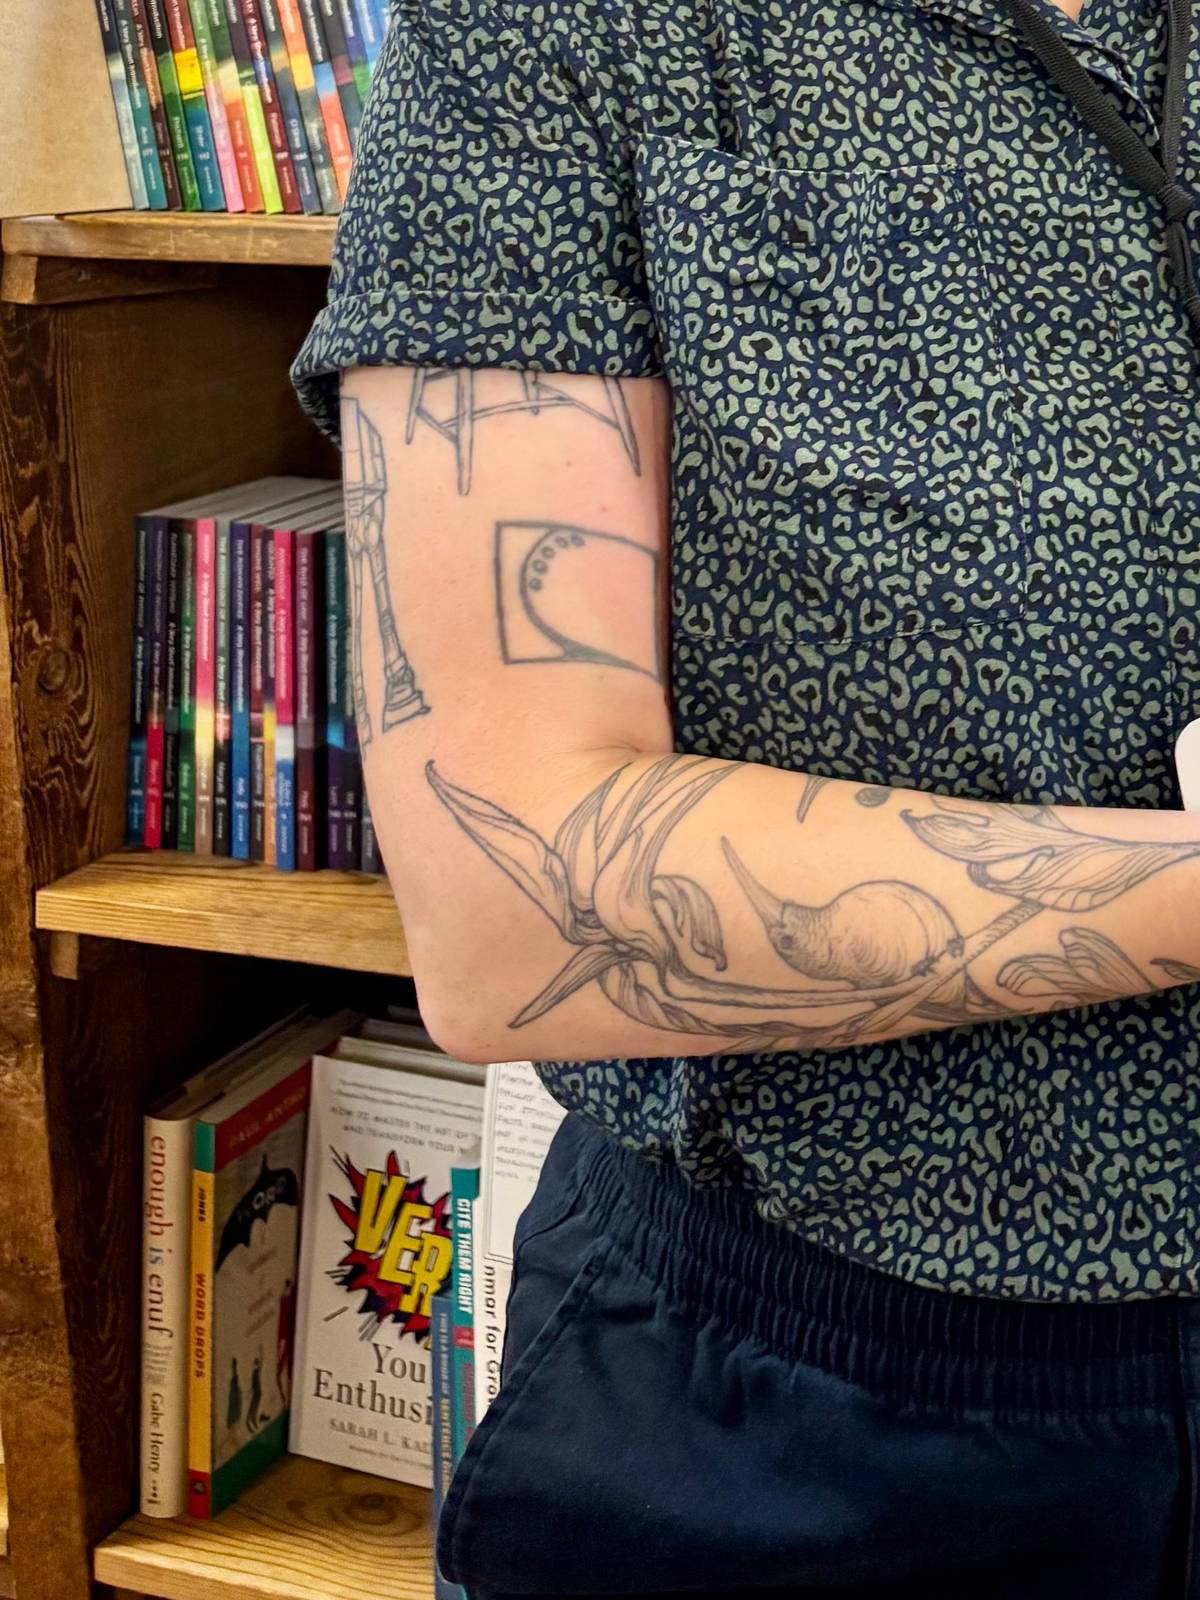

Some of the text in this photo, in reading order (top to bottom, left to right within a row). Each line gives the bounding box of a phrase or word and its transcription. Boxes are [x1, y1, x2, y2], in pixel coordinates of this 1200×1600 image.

[148, 1135, 174, 1238] enough
[148, 1246, 173, 1266] is
[456, 1197, 473, 1315] CITE THEM RIGHT
[146, 1272, 174, 1339] enuf
[194, 1273, 207, 1379] WORD DROPS
[485, 1323, 500, 1353] for
[372, 1343, 426, 1384] You
[151, 1391, 164, 1429] Gabe
[147, 1432, 165, 1476] Henry
